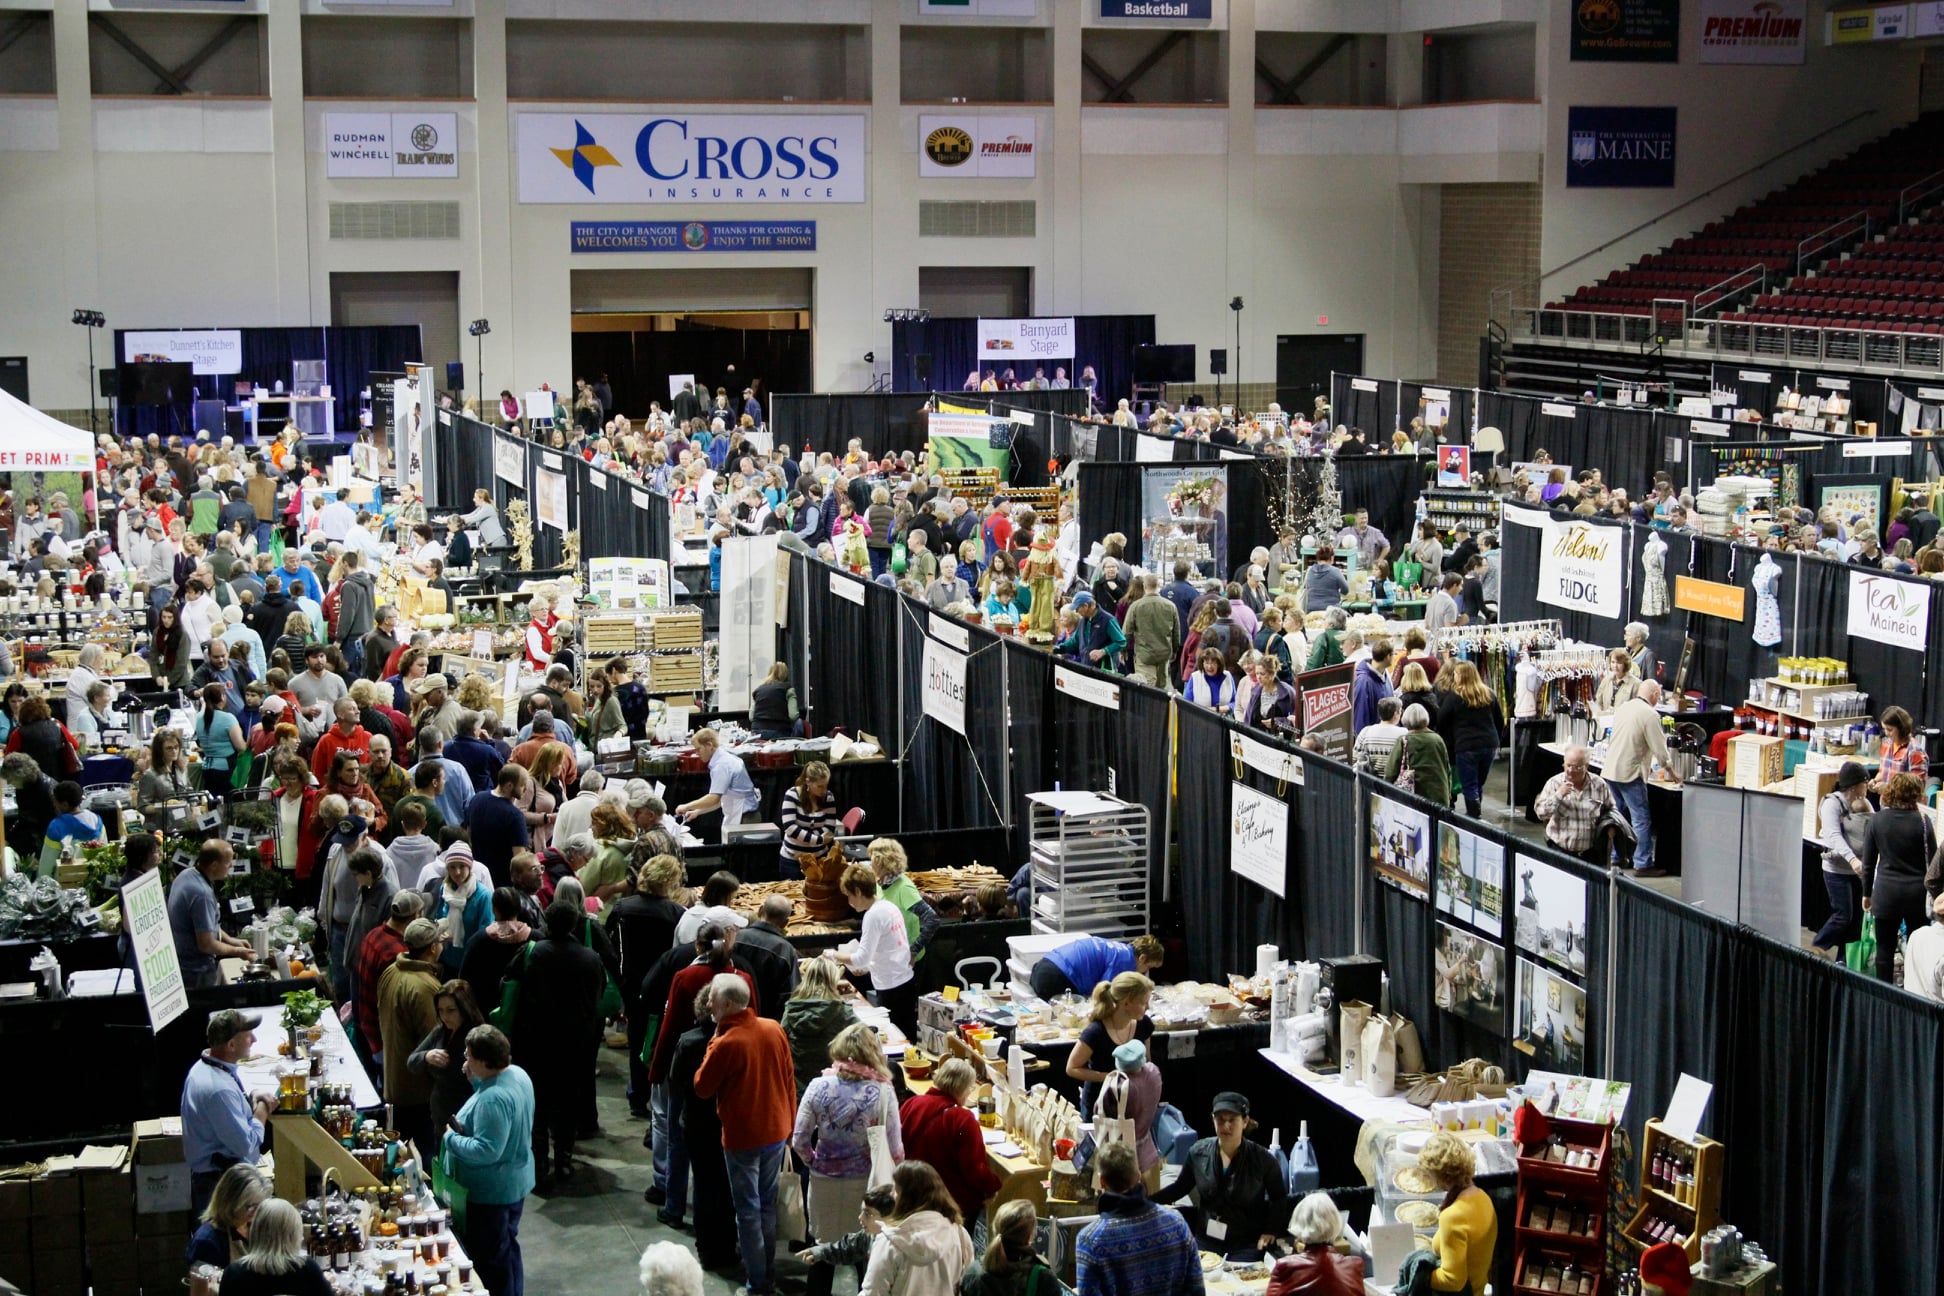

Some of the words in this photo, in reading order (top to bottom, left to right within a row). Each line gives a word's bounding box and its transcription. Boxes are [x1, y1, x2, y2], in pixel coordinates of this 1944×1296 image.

[1125, 2, 1188, 16] Basketball
[1704, 11, 1801, 38] PREMIUM
[1703, 38, 1738, 46] CHOICE
[333, 134, 386, 143] RUDMAN
[981, 140, 1033, 153] PREMIUM
[330, 151, 390, 159] WINCHELL
[635, 119, 839, 181] CROSS
[1598, 140, 1672, 160] MAINE
[649, 187, 833, 198] INSURANCE
[576, 228, 594, 236] THE
[597, 227, 619, 236] CITY
[621, 227, 635, 236] OF
[637, 227, 678, 236] BANGOR
[713, 227, 747, 235] THANKS
[749, 227, 766, 235] FOR
[767, 227, 803, 235] COMING
[804, 227, 811, 235] &
[577, 237, 648, 247] WELCOMES
[650, 236, 678, 247] YOU
[714, 236, 747, 247] ENJOY
[751, 236, 771, 246] THE
[777, 236, 811, 246] SHOW!
[1020, 323, 1068, 340] Barnyard
[170, 340, 205, 352] Dunnett's
[207, 340, 235, 351] Kitchen
[1030, 340, 1060, 355] Stage
[192, 353, 217, 367] Stage
[0, 453, 16, 464] ET
[26, 452, 69, 465] PRIM!
[1144, 469, 1183, 478] Northwoods
[1553, 526, 1609, 561] Nelson's
[1560, 578, 1599, 604] FUDGE
[1859, 577, 1899, 614] Tea
[1870, 612, 1917, 636] Maineia
[929, 656, 964, 702] Hotties
[1308, 688, 1346, 712] FLAGG'S
[1311, 708, 1331, 722] BANGOR
[1331, 700, 1347, 712] MAINE
[1252, 822, 1274, 844] Bakery
[130, 883, 161, 918] MAINE
[134, 905, 164, 935] GROCERS
[144, 944, 175, 986] FOOD
[150, 970, 179, 1001] PRODUCERS
[157, 997, 182, 1021] ASSOCIATION
